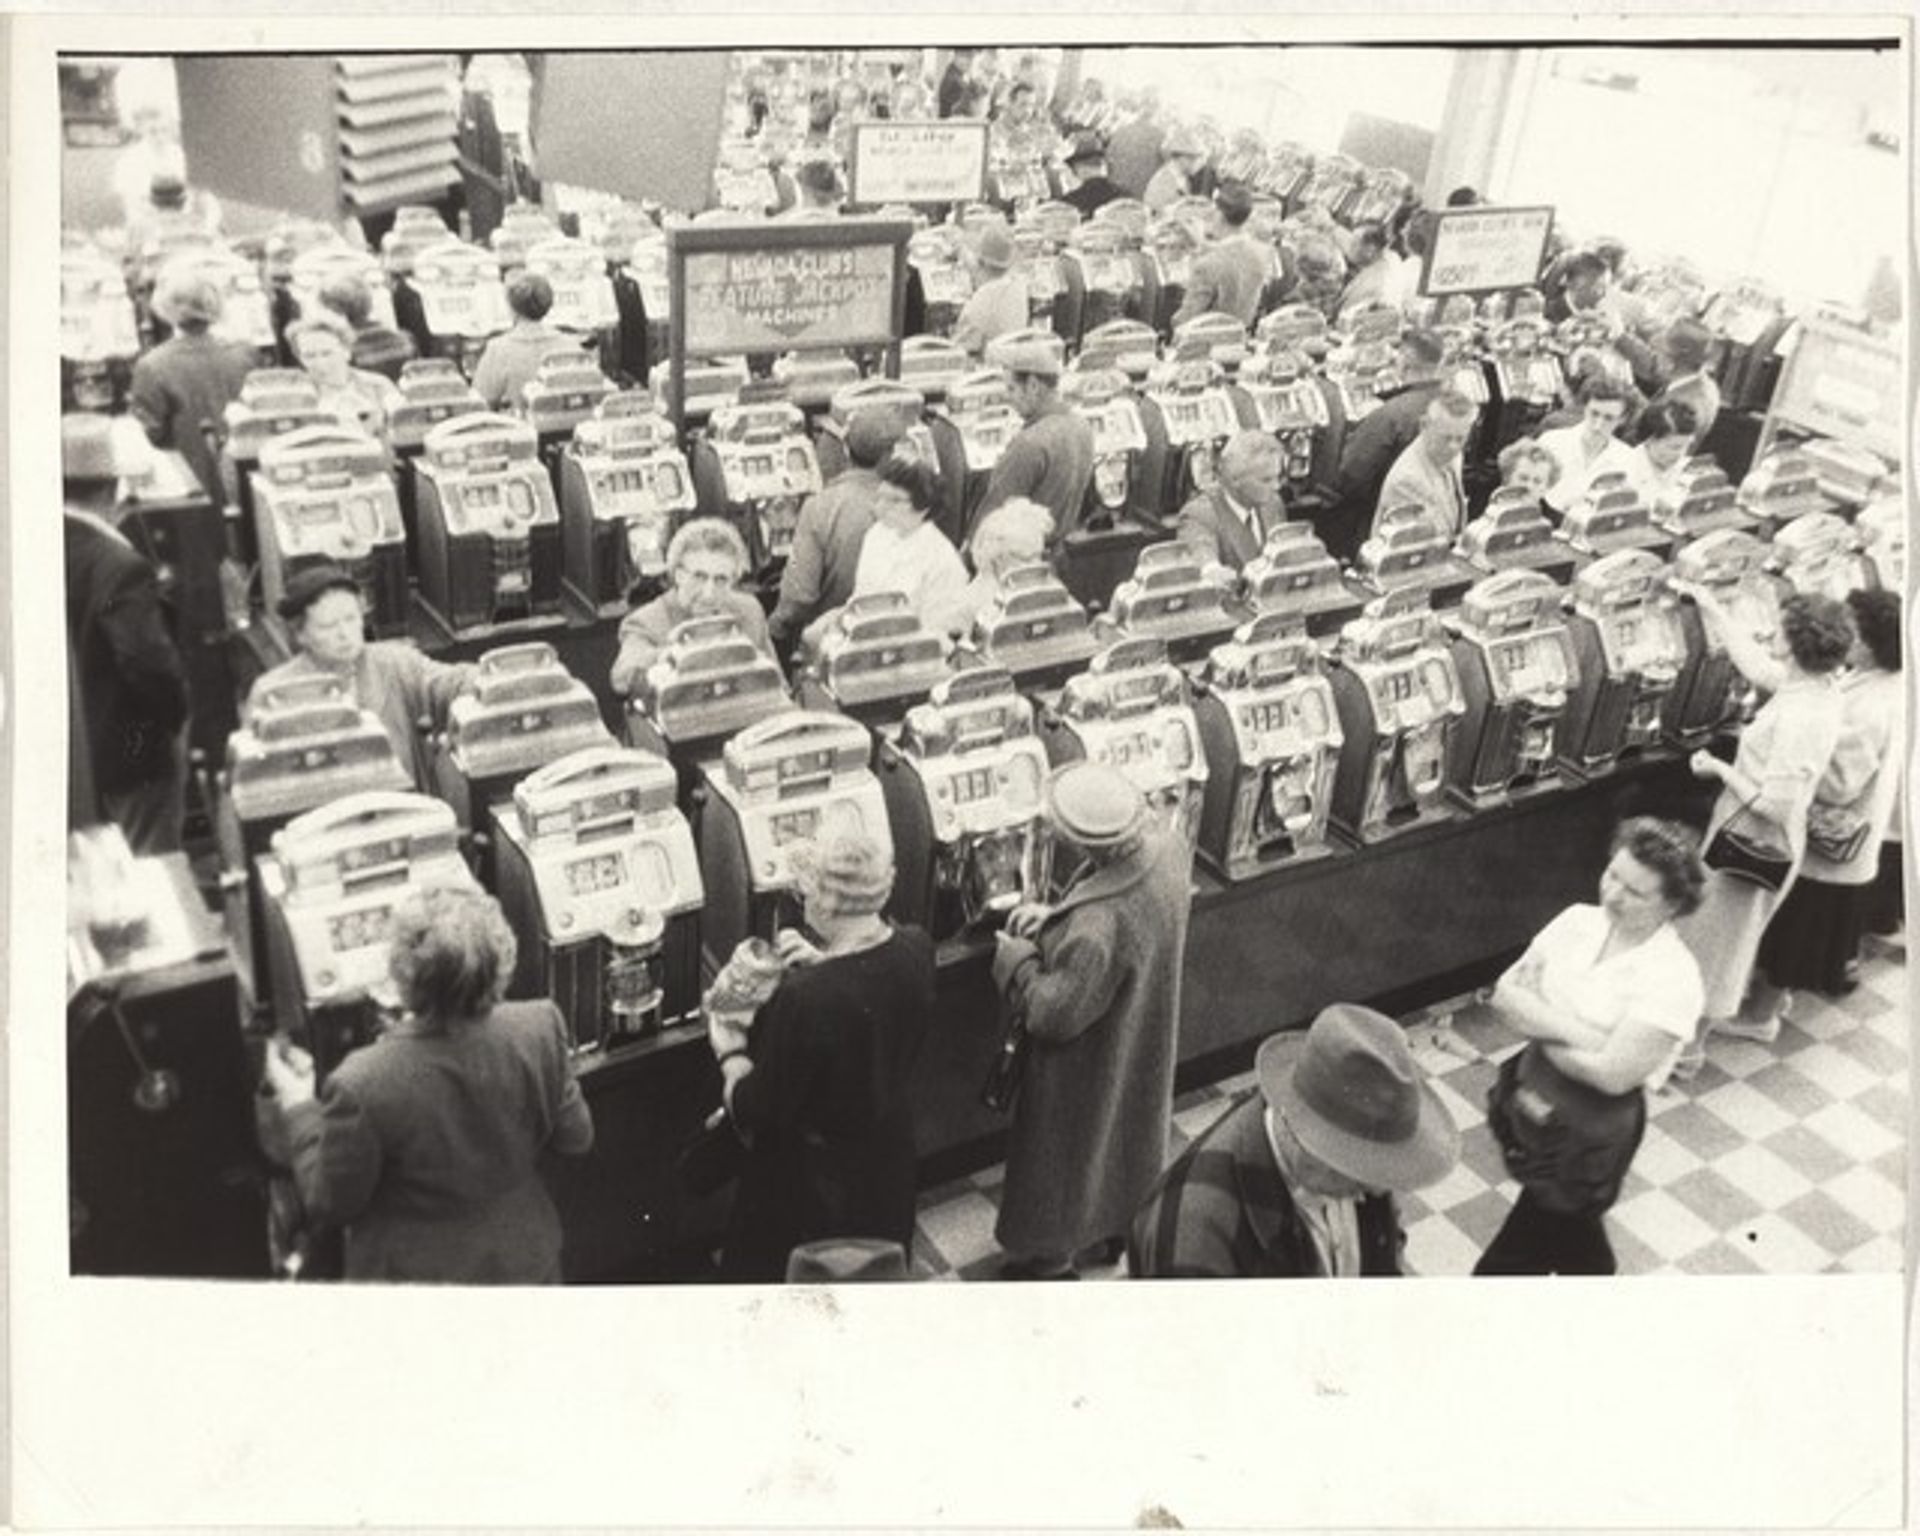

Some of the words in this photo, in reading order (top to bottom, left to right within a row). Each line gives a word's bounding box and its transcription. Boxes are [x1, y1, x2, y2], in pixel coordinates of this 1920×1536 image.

[698, 281, 787, 310] FEATURE
[793, 276, 876, 304] JACKPOT
[744, 304, 839, 326] MACHINES
